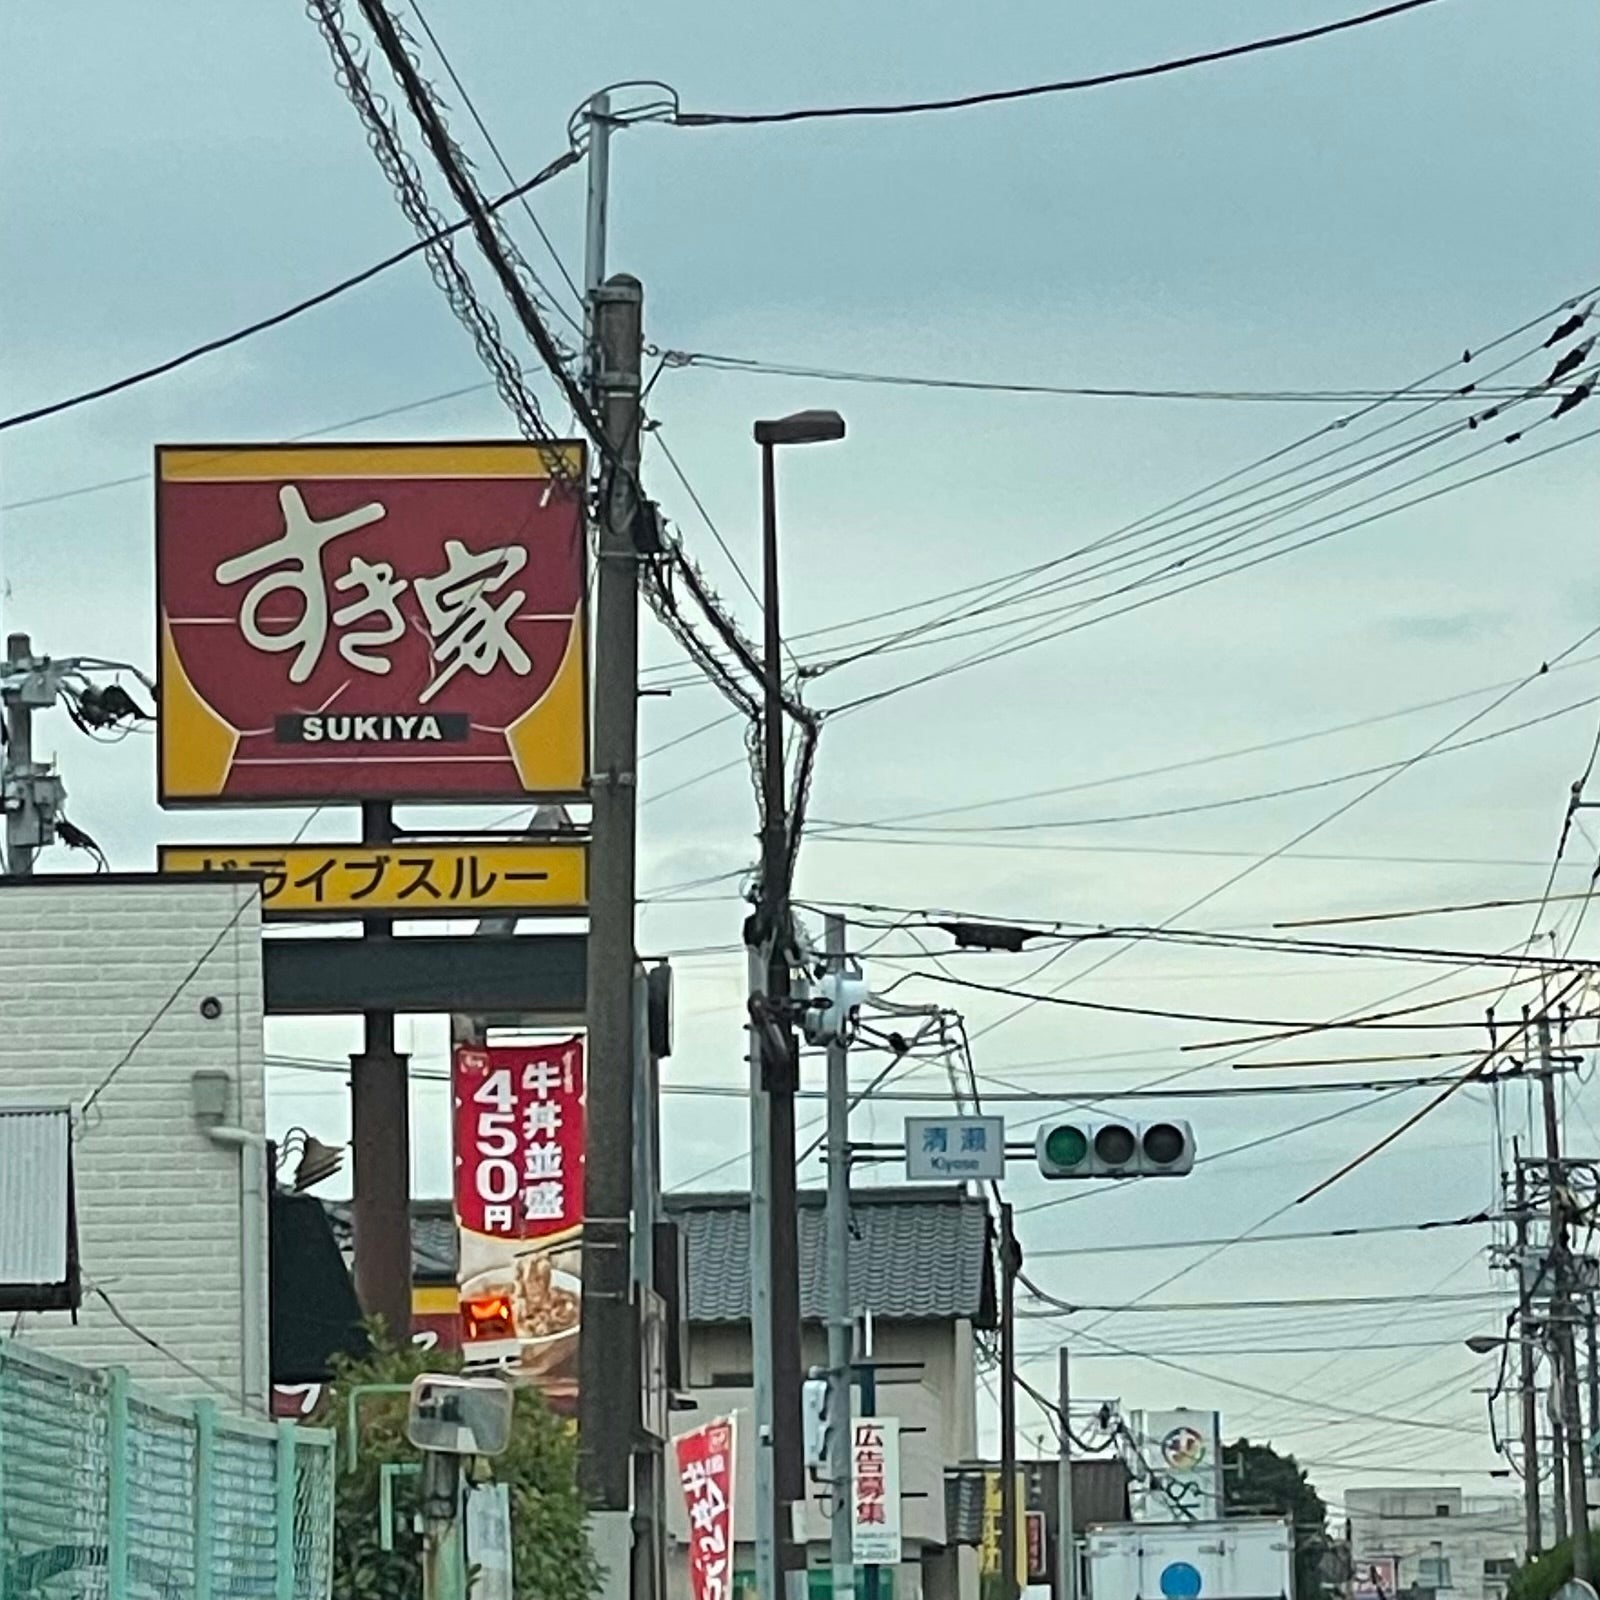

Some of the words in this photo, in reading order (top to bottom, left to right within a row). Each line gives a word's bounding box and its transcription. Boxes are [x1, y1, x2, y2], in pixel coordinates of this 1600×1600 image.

[215, 485, 532, 704] すき家
[302, 715, 442, 742] SUKIYA
[473, 1069, 519, 1232] 450円
[522, 1061, 565, 1220] 牛丼並盛
[855, 1424, 886, 1525] 広告募集
